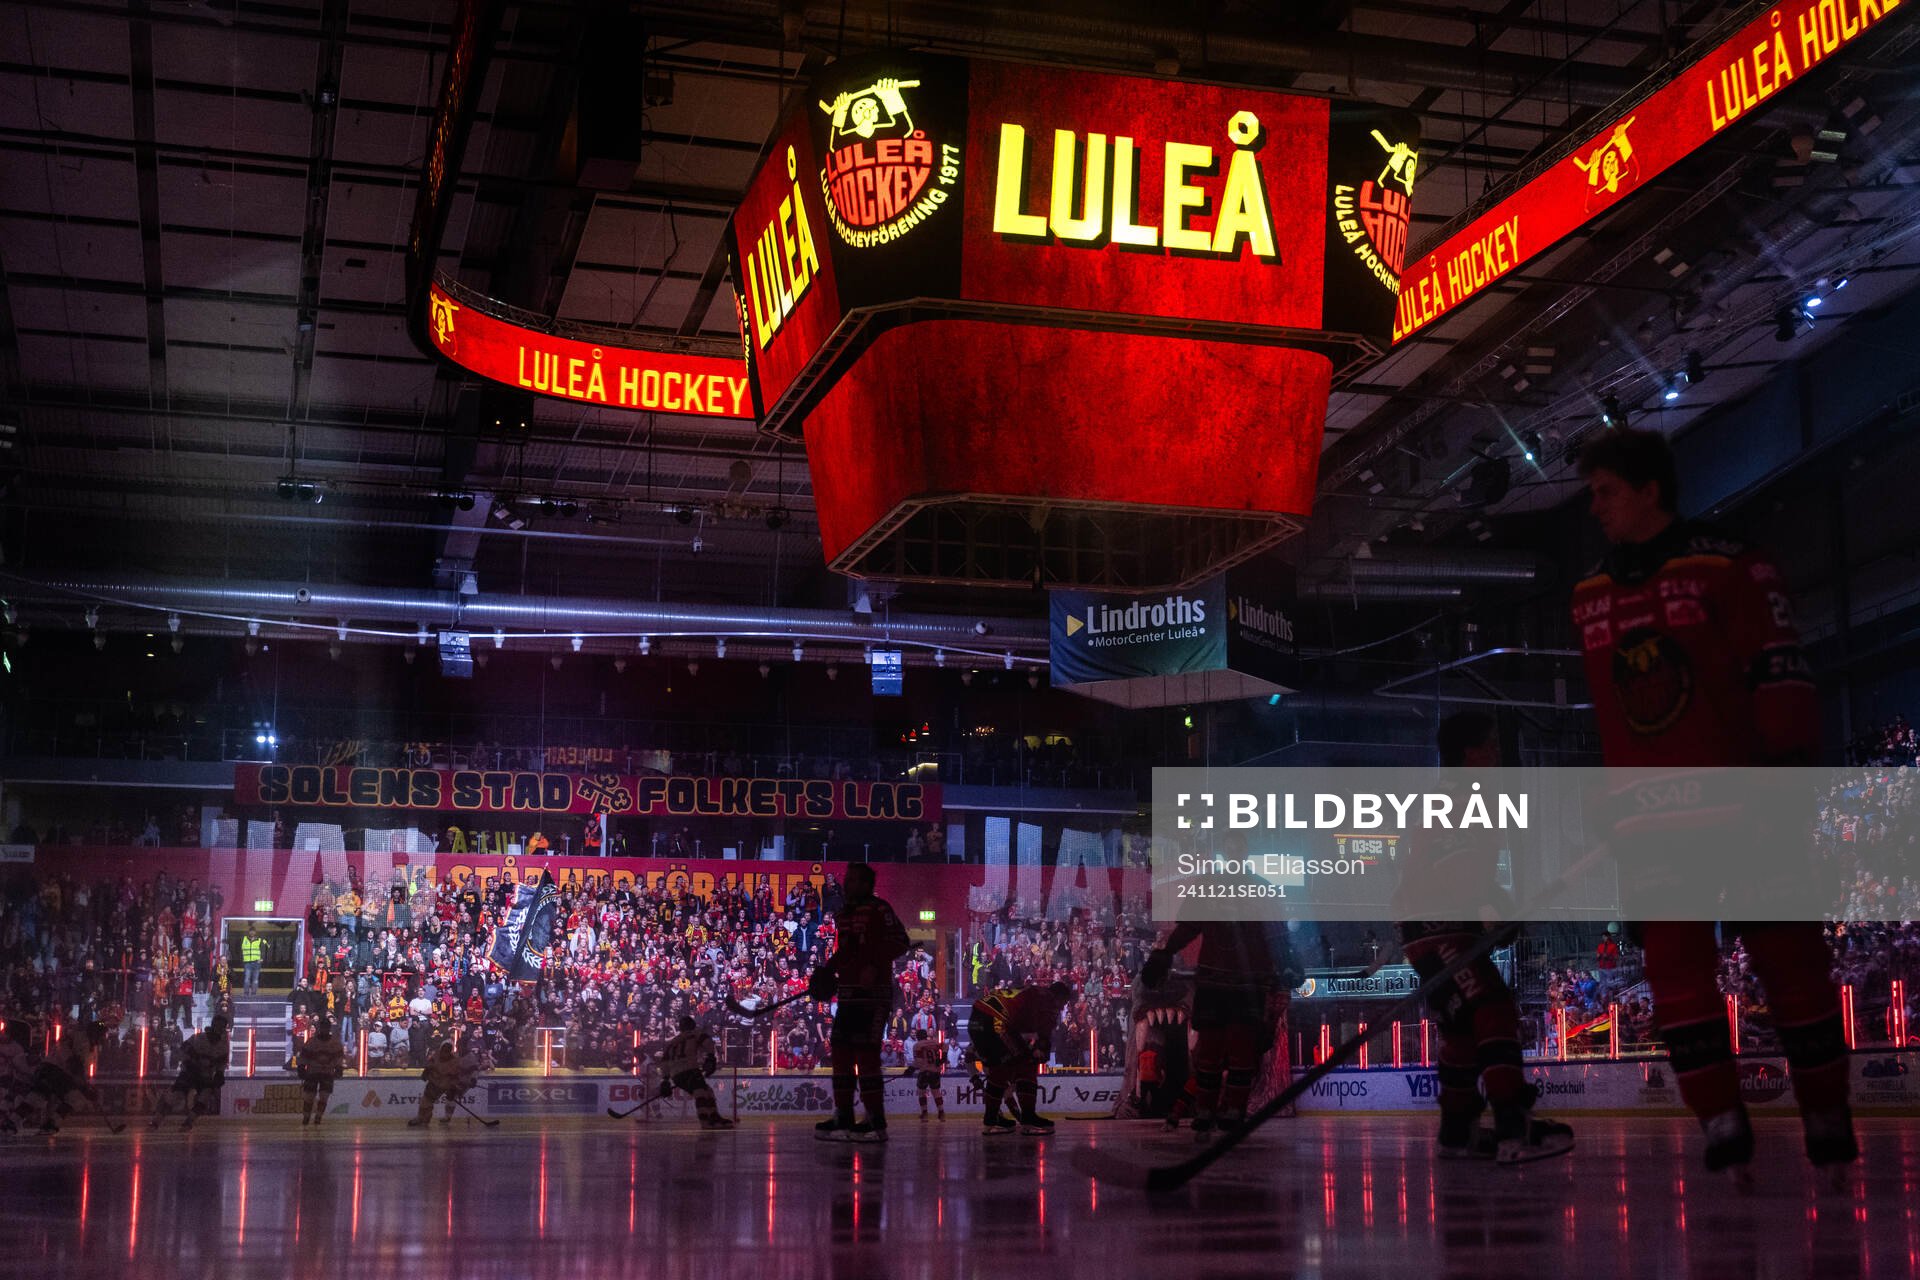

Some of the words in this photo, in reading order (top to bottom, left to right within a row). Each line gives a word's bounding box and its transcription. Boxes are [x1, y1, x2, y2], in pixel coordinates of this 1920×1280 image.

[1707, 11, 1794, 132] LULEÅ
[1799, 0, 1901, 69] HOCK
[826, 129, 933, 183] LULEÅ
[938, 143, 960, 185] 1977
[830, 165, 931, 227] HOCKEY
[993, 110, 1278, 260] LULEÅ
[1334, 184, 1366, 245] LULEÅ
[747, 144, 820, 350] LULEÅ
[1447, 215, 1519, 305] HOCKEY
[519, 346, 607, 402] LULEÅ
[619, 366, 749, 415] HOCKEY
[1087, 595, 1206, 634] Lindroths
[1095, 631, 1165, 648] MotorCenter
[1168, 625, 1198, 640] Luleå
[1238, 596, 1294, 642] Lindroths
[258, 765, 442, 809] SOLENS
[452, 771, 573, 811] STAD
[637, 776, 835, 818] FOLKETS
[842, 781, 924, 820] LAG
[1352, 840, 1383, 854] 03:52
[1327, 975, 1381, 993] Kunder
[1311, 1076, 1368, 1106] winpos
